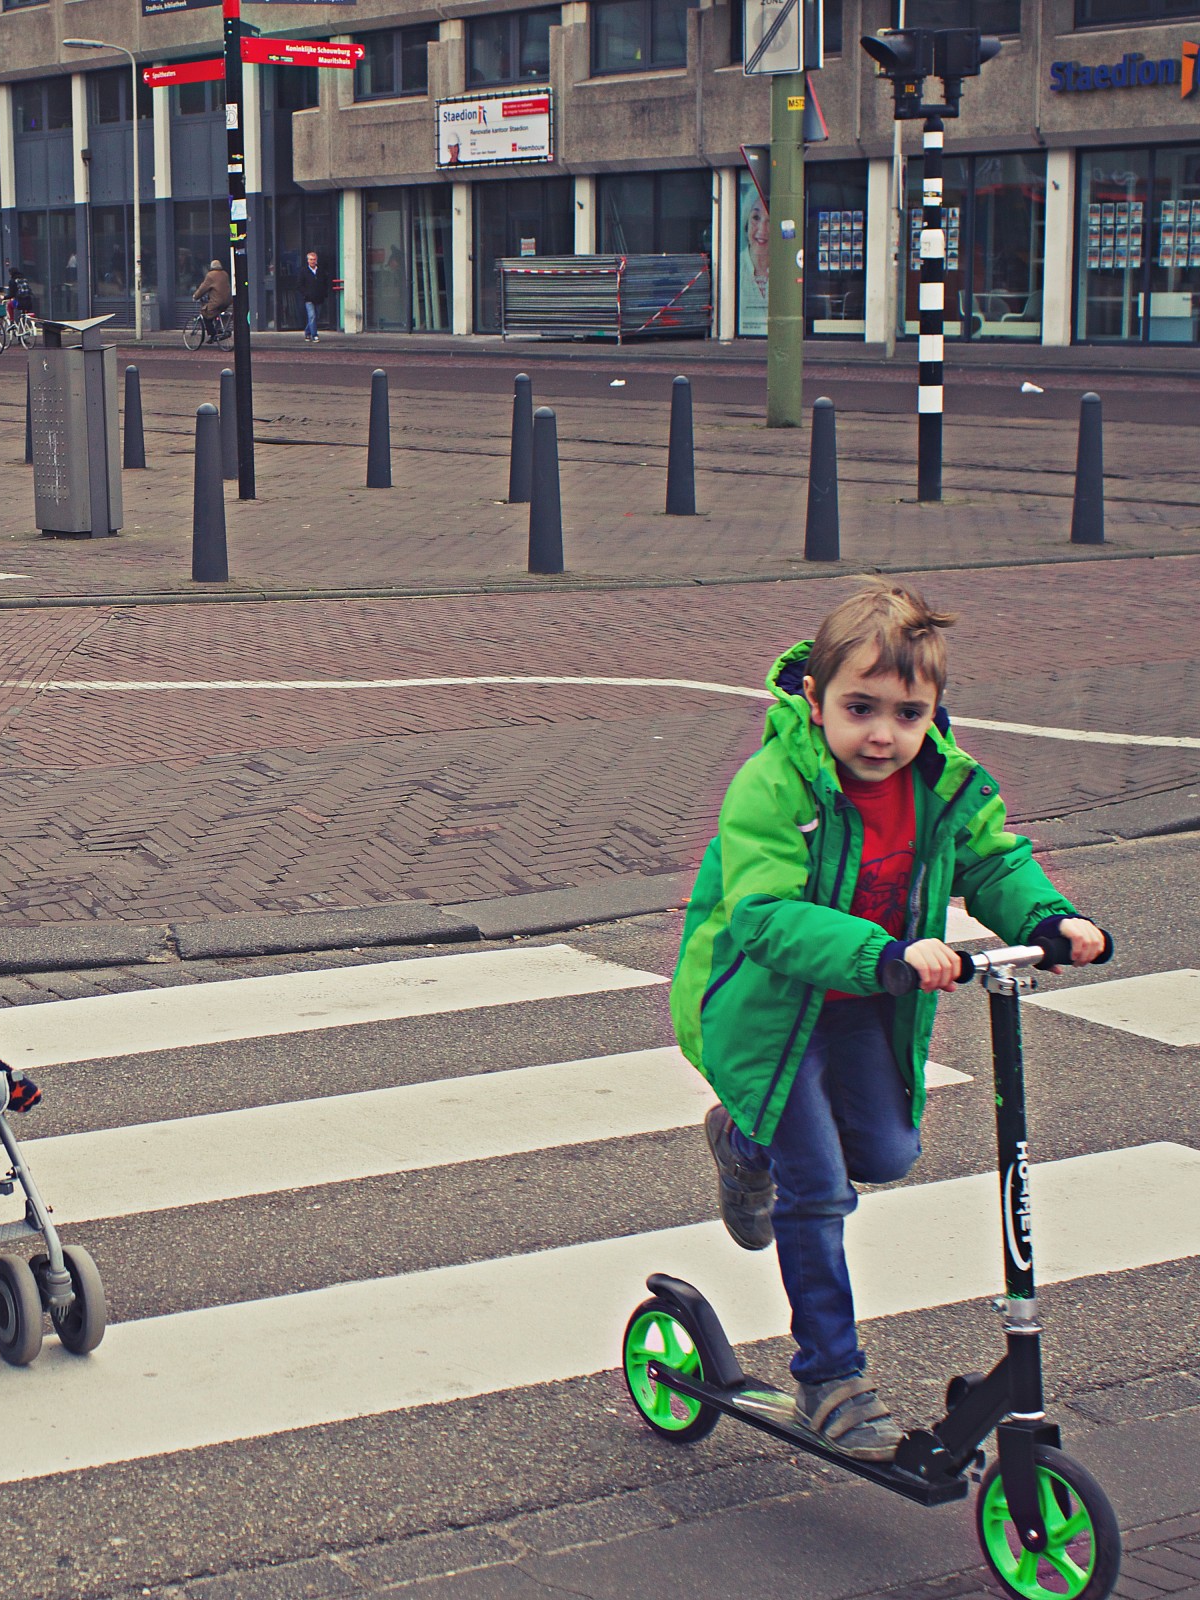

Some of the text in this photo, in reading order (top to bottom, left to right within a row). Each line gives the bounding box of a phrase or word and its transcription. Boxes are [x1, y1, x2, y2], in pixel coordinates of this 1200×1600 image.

[285, 45, 351, 57] Koninklijke Schouwburg
[1050, 52, 1175, 91] Staedion
[443, 109, 477, 122] Staedion
